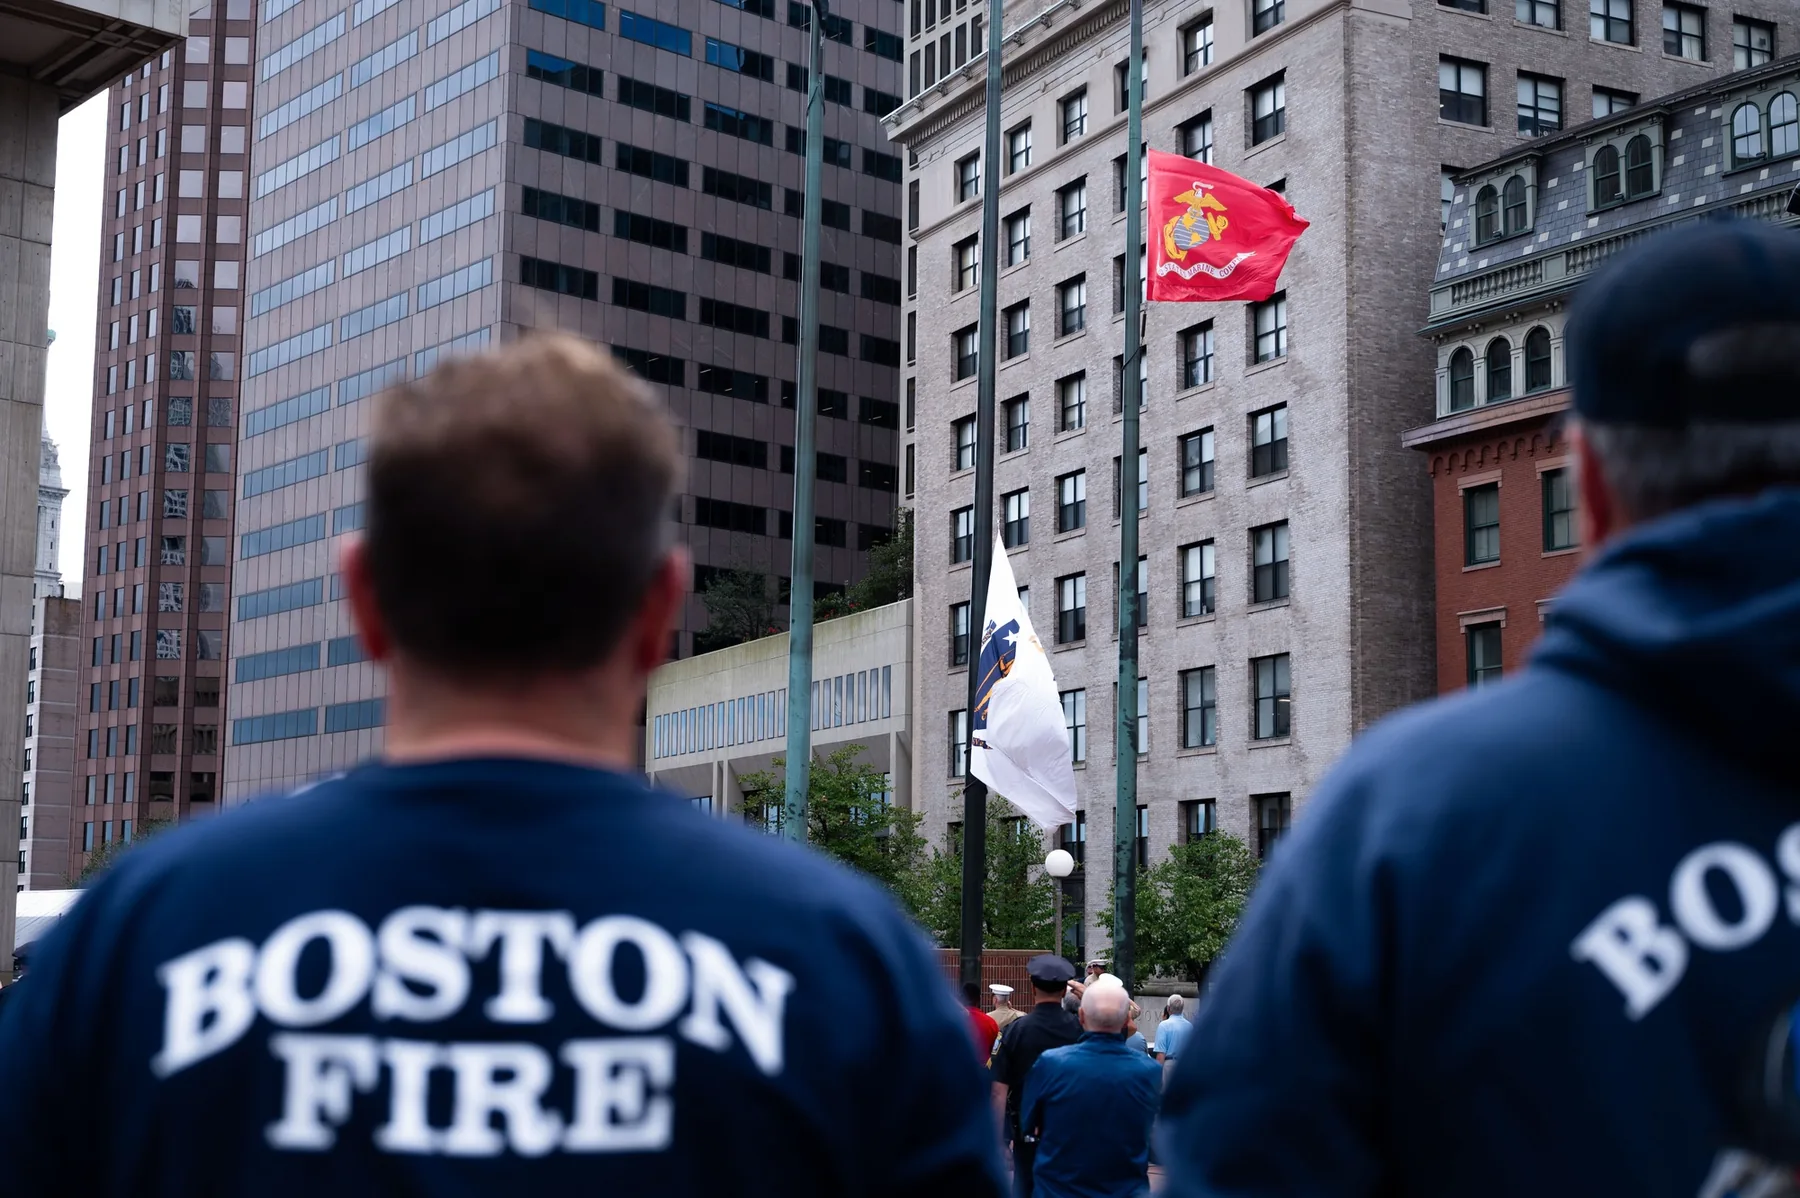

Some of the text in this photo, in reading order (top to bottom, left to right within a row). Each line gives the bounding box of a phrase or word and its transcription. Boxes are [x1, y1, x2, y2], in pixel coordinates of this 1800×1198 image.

[1188, 264, 1215, 276] MARINE
[152, 905, 795, 1077] BOSTON
[1569, 822, 1800, 1022] BO
[265, 1033, 676, 1157] FIRE
